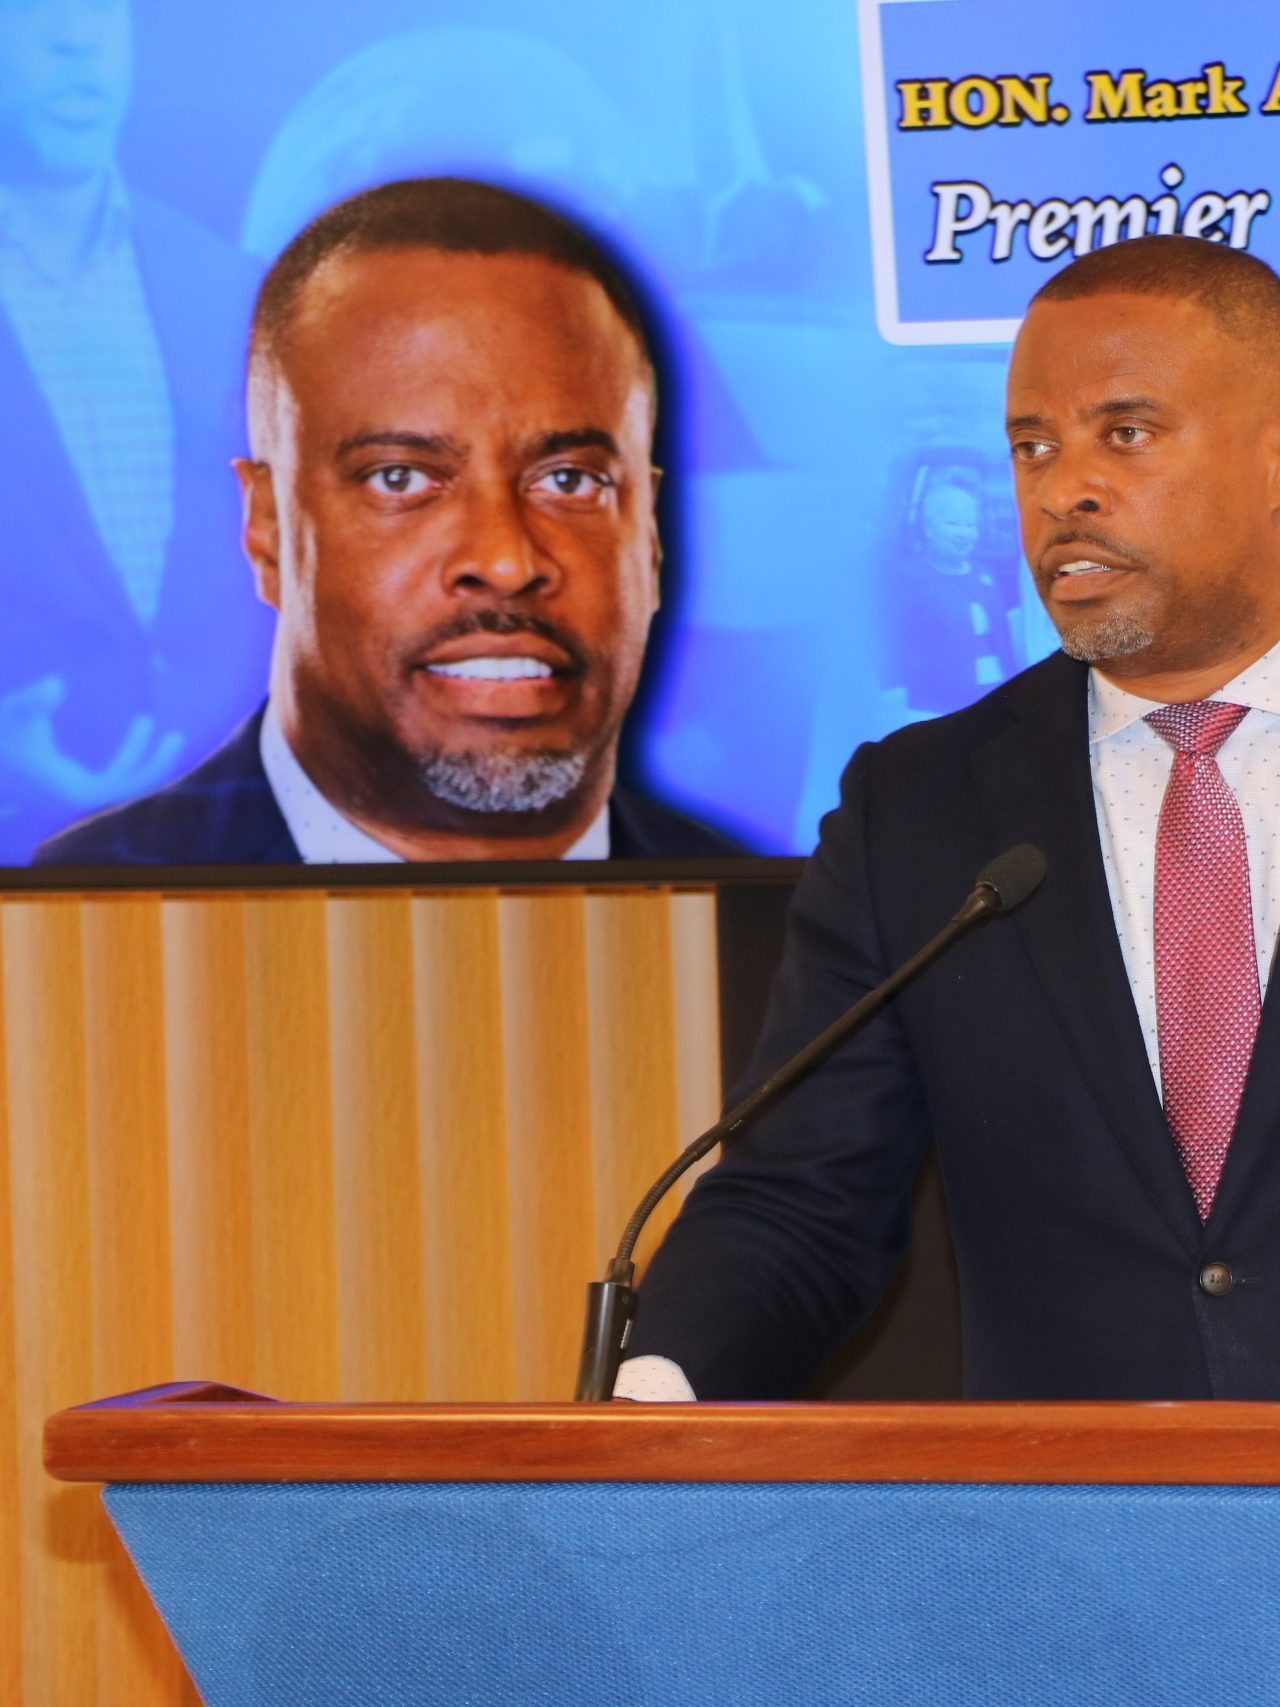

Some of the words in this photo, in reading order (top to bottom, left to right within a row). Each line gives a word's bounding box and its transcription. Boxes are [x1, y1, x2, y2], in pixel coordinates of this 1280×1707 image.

[896, 73, 1070, 131] HON.
[1085, 62, 1248, 124] Mark
[924, 162, 1271, 264] Premier
